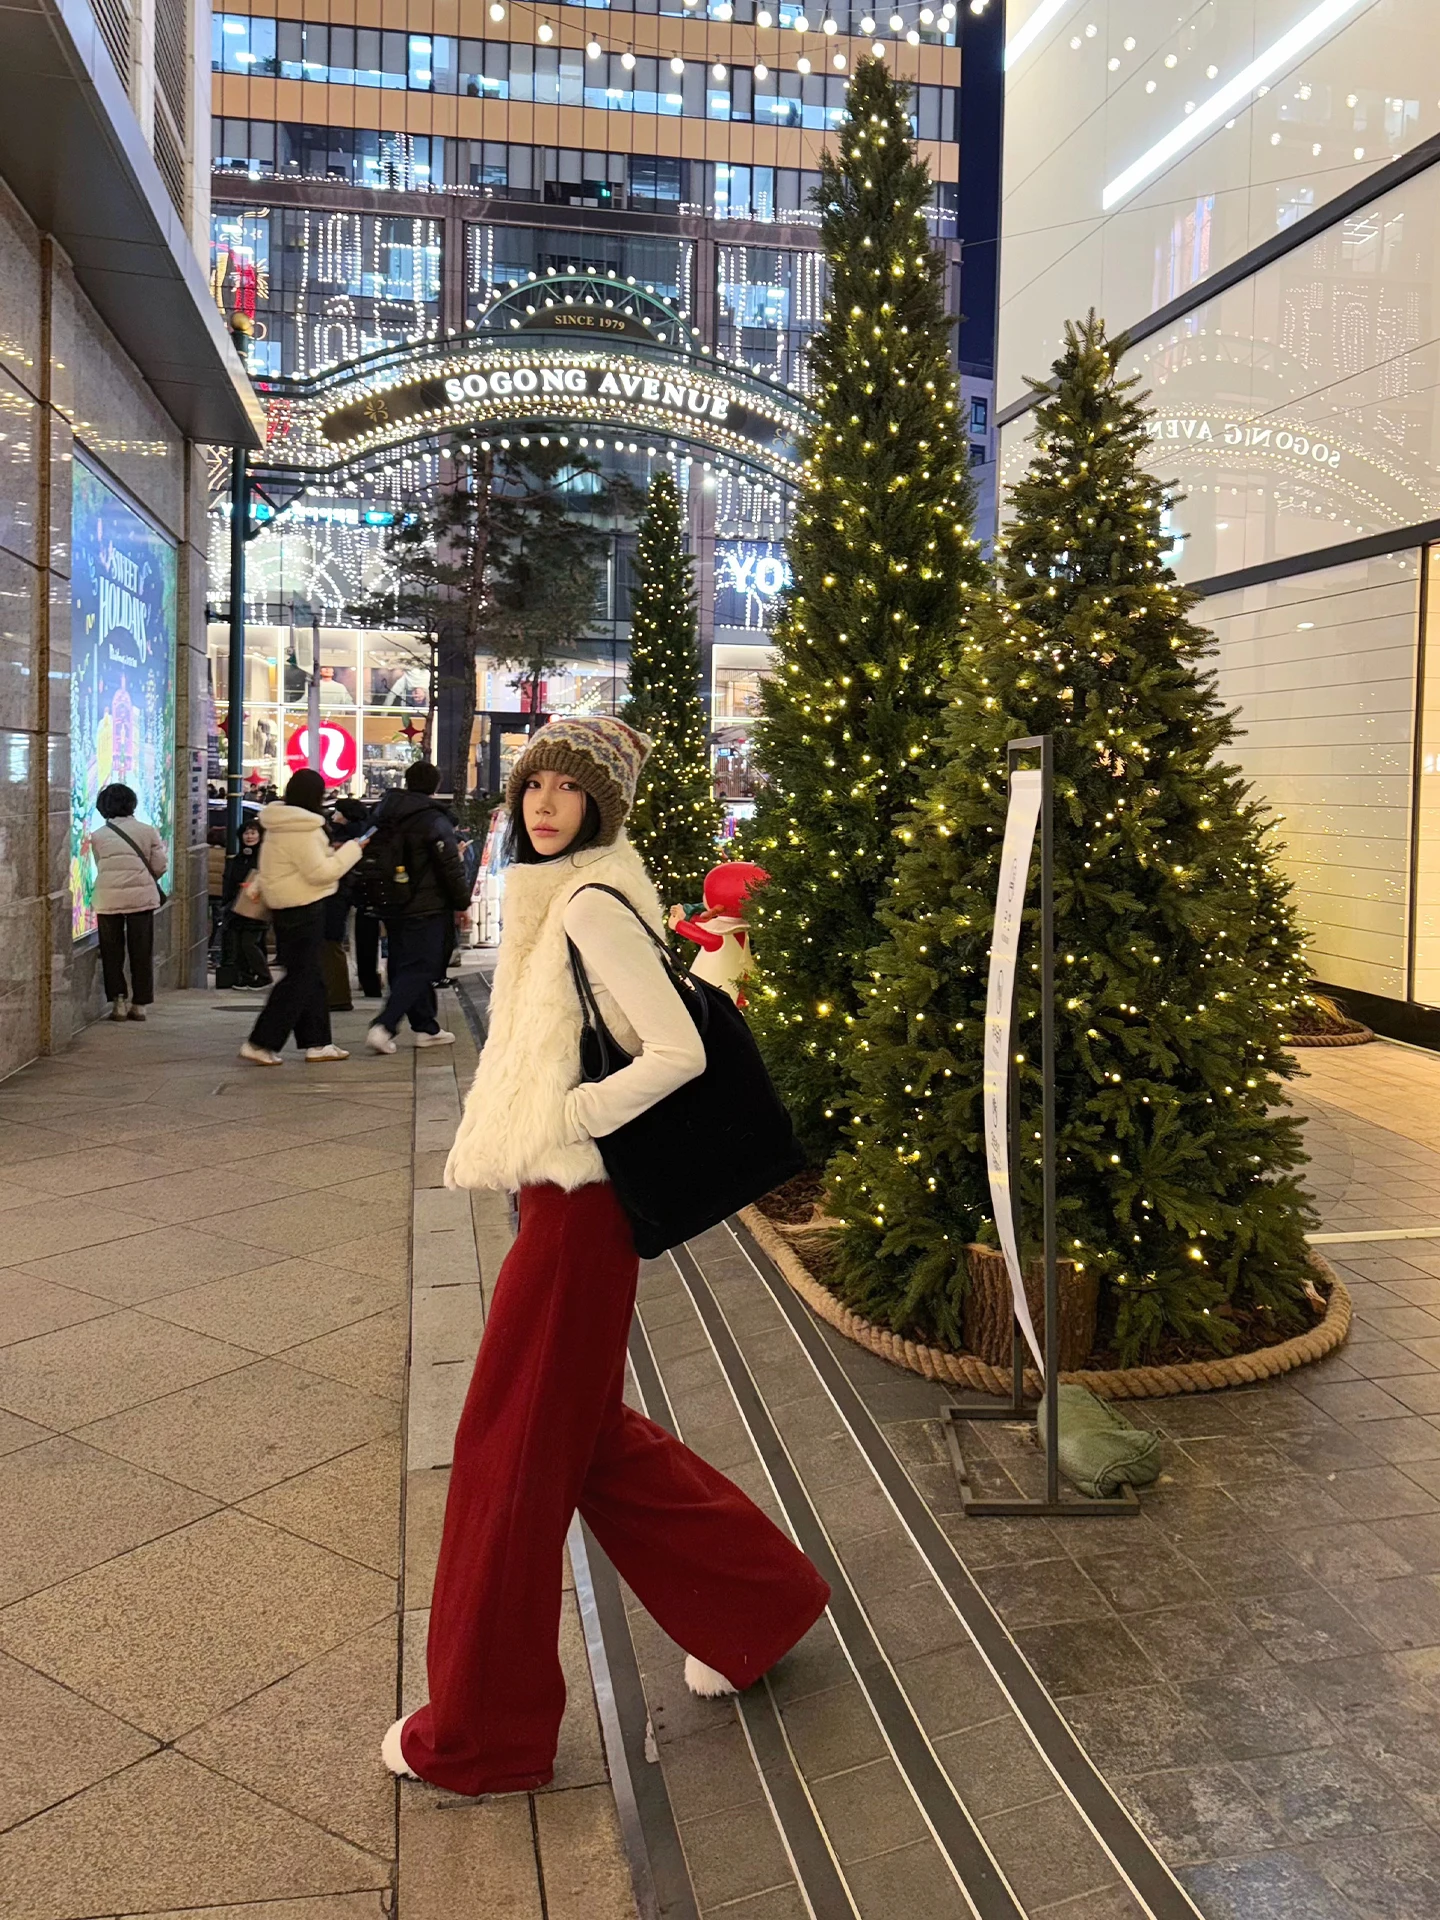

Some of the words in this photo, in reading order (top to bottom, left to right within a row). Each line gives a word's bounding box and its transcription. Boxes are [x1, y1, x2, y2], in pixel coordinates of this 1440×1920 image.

[554, 314, 595, 326] SINCE
[599, 317, 625, 330] 1979
[444, 368, 587, 402] SOGONG
[597, 371, 730, 420] AVENUE
[111, 547, 139, 593] SWEET
[728, 555, 794, 596] YO
[98, 576, 147, 664] HOLIDAYS
